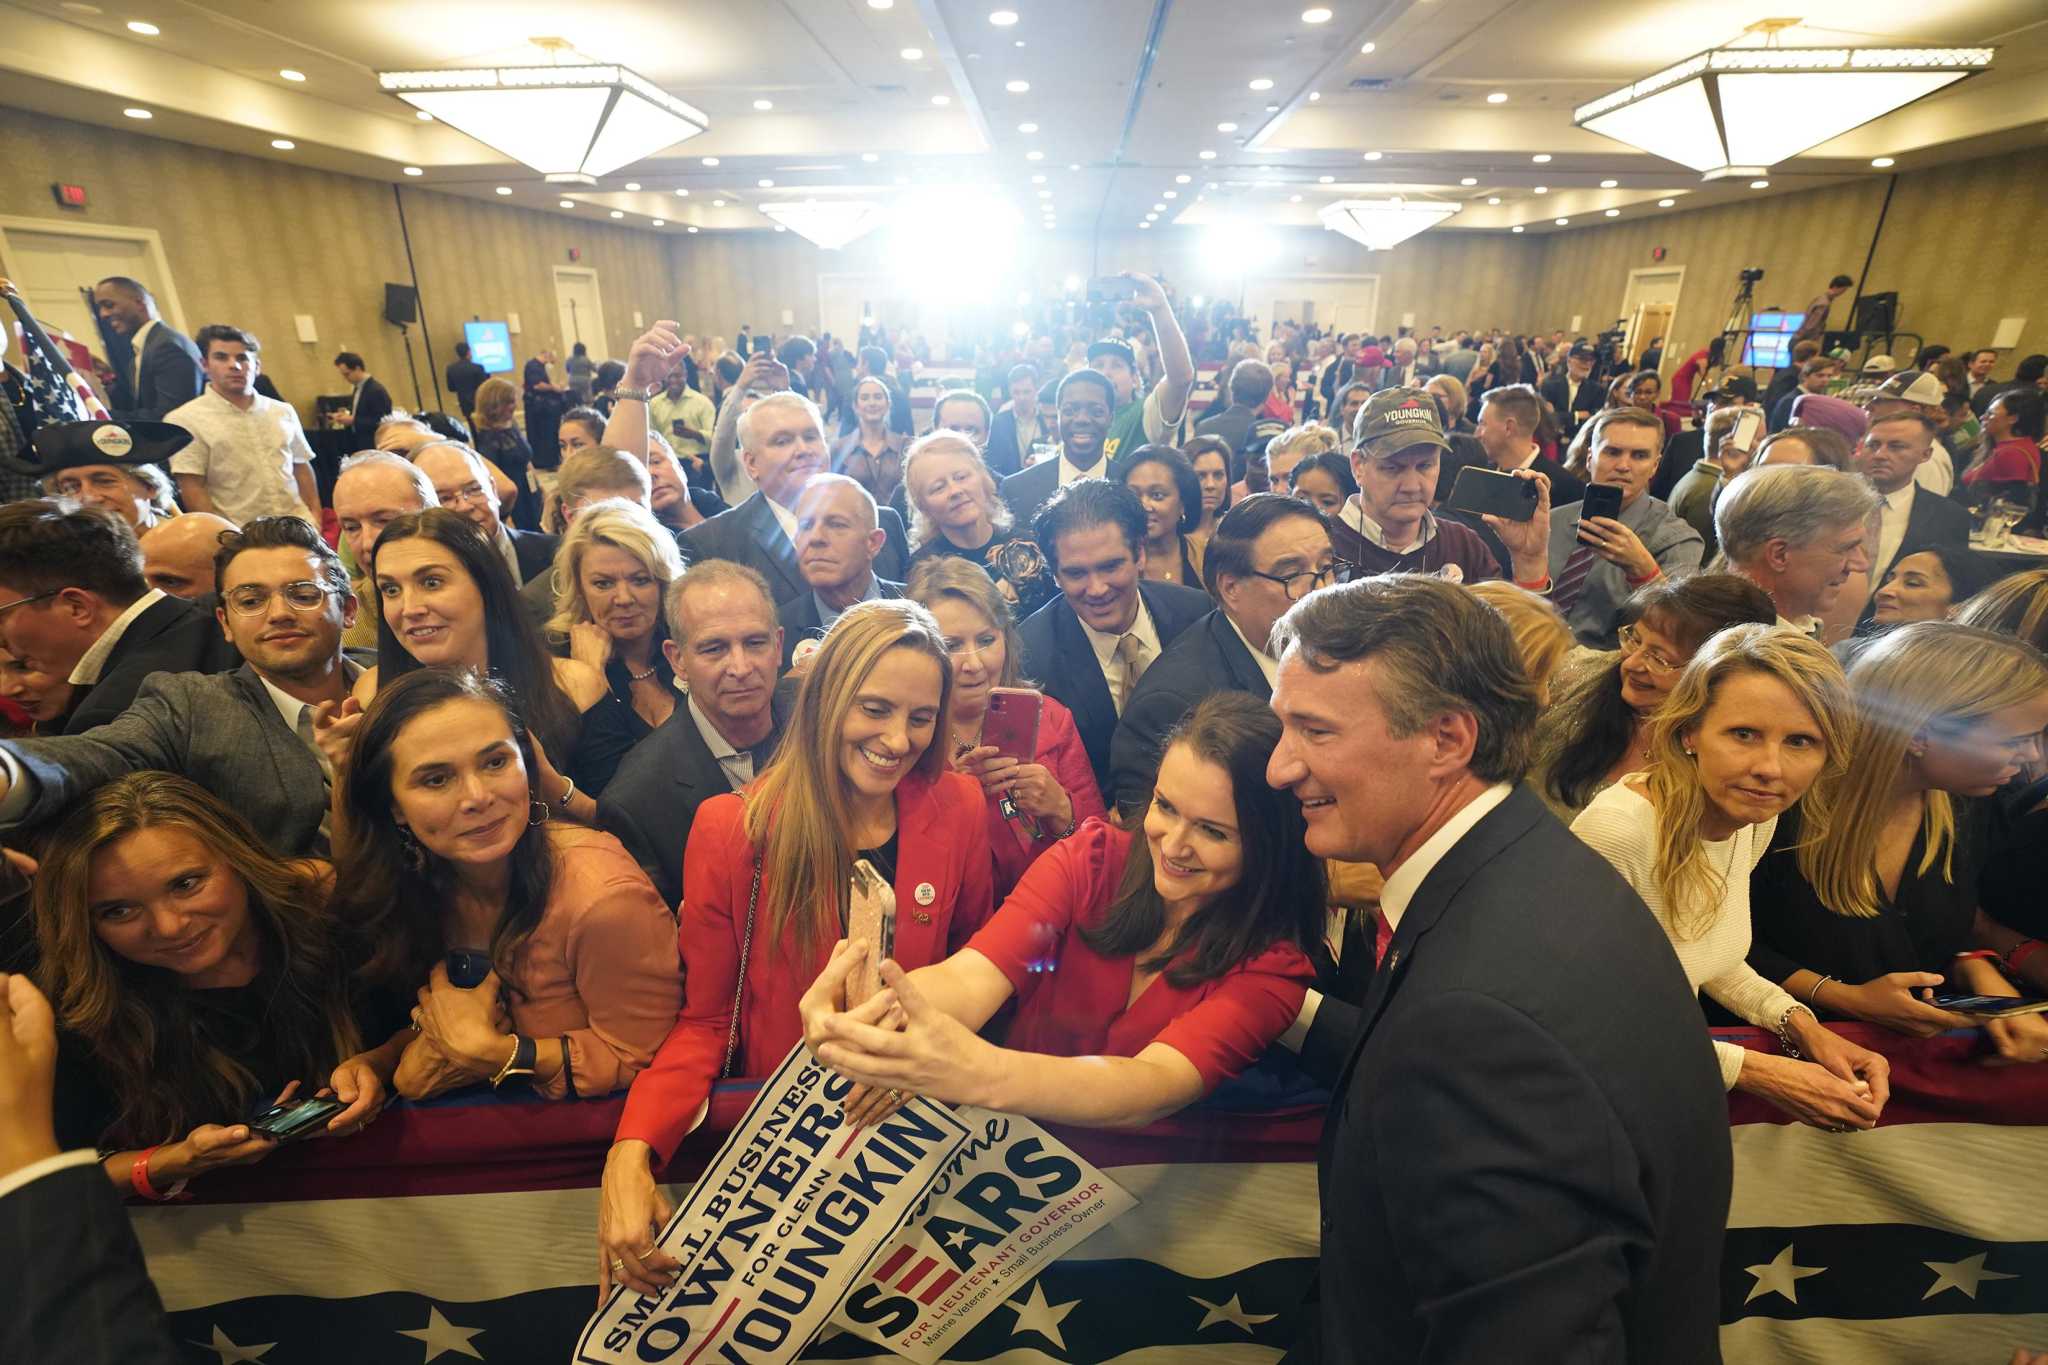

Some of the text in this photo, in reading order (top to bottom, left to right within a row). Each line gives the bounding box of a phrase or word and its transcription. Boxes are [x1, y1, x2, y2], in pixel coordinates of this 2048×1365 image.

[742, 1168, 832, 1287] FOR GLENN
[845, 1137, 1082, 1338] SEARS
[902, 1321, 933, 1348] FOR
[931, 1244, 1018, 1320] LIEUTENANT
[1019, 1183, 1103, 1243] GOVERNOR
[953, 1287, 992, 1319] Veteran
[1000, 1253, 1029, 1278] Small
[1027, 1222, 1073, 1256] Business
[1071, 1198, 1107, 1223] Owner
